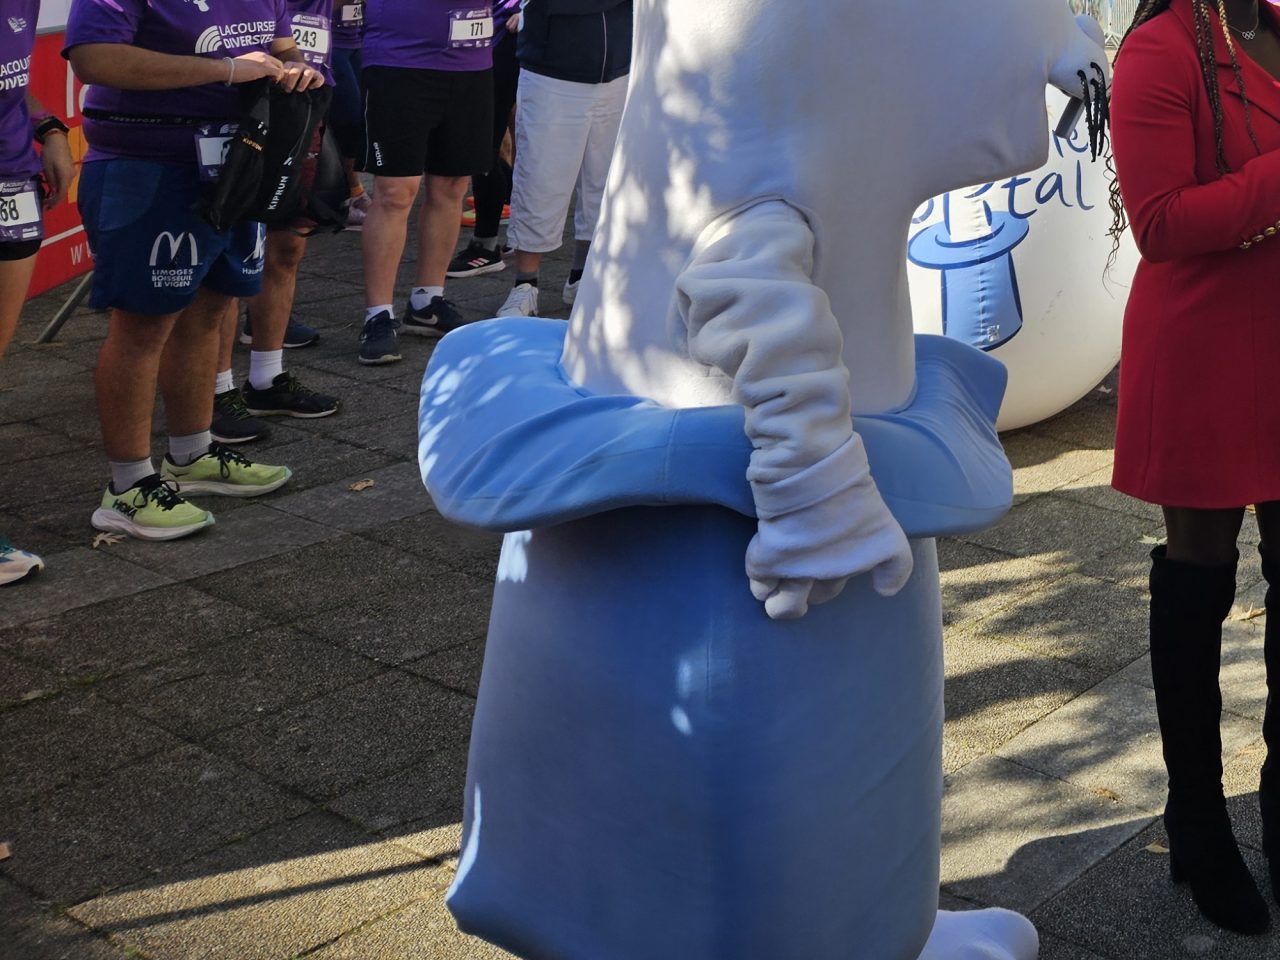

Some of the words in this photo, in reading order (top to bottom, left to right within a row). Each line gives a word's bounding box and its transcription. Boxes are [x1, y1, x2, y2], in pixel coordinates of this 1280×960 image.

[293, 28, 317, 48] 243
[470, 22, 483, 36] 171
[267, 175, 288, 210] KIPRUN
